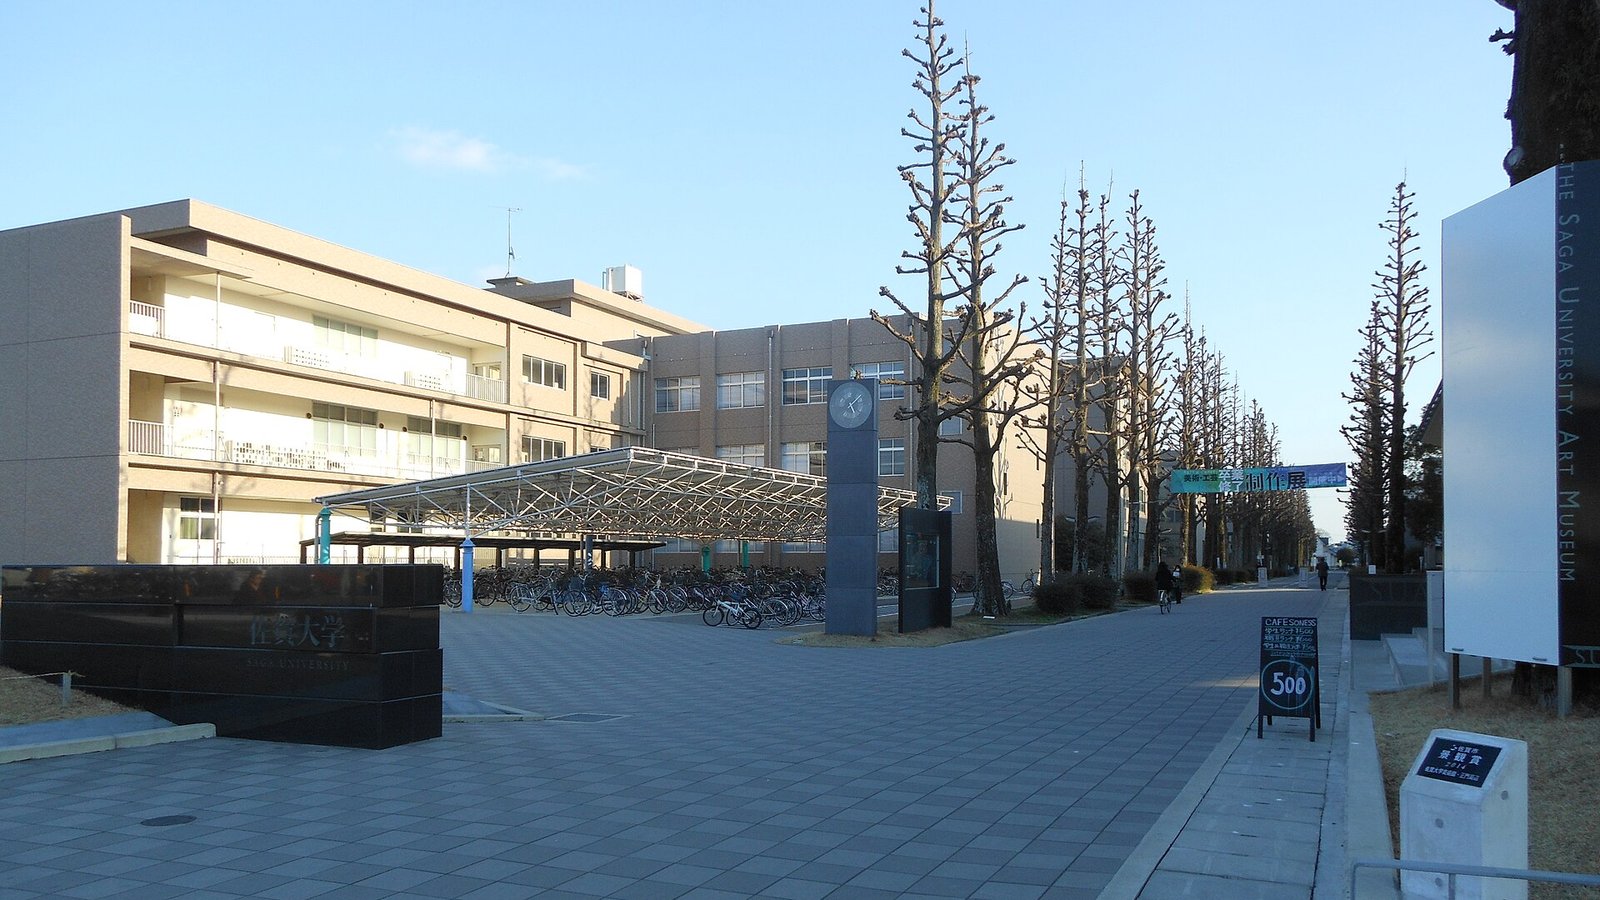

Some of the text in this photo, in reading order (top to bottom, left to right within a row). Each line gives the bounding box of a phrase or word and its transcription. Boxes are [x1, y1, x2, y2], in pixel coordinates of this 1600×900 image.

[1559, 162, 1580, 581] THE SAGA UNIVERSITY ART MUSEUM
[250, 613, 345, 648] 佐賀大学
[1265, 618, 1288, 626] CAFE
[279, 658, 350, 671] UNIVERSITY
[1270, 672, 1306, 695] 500
